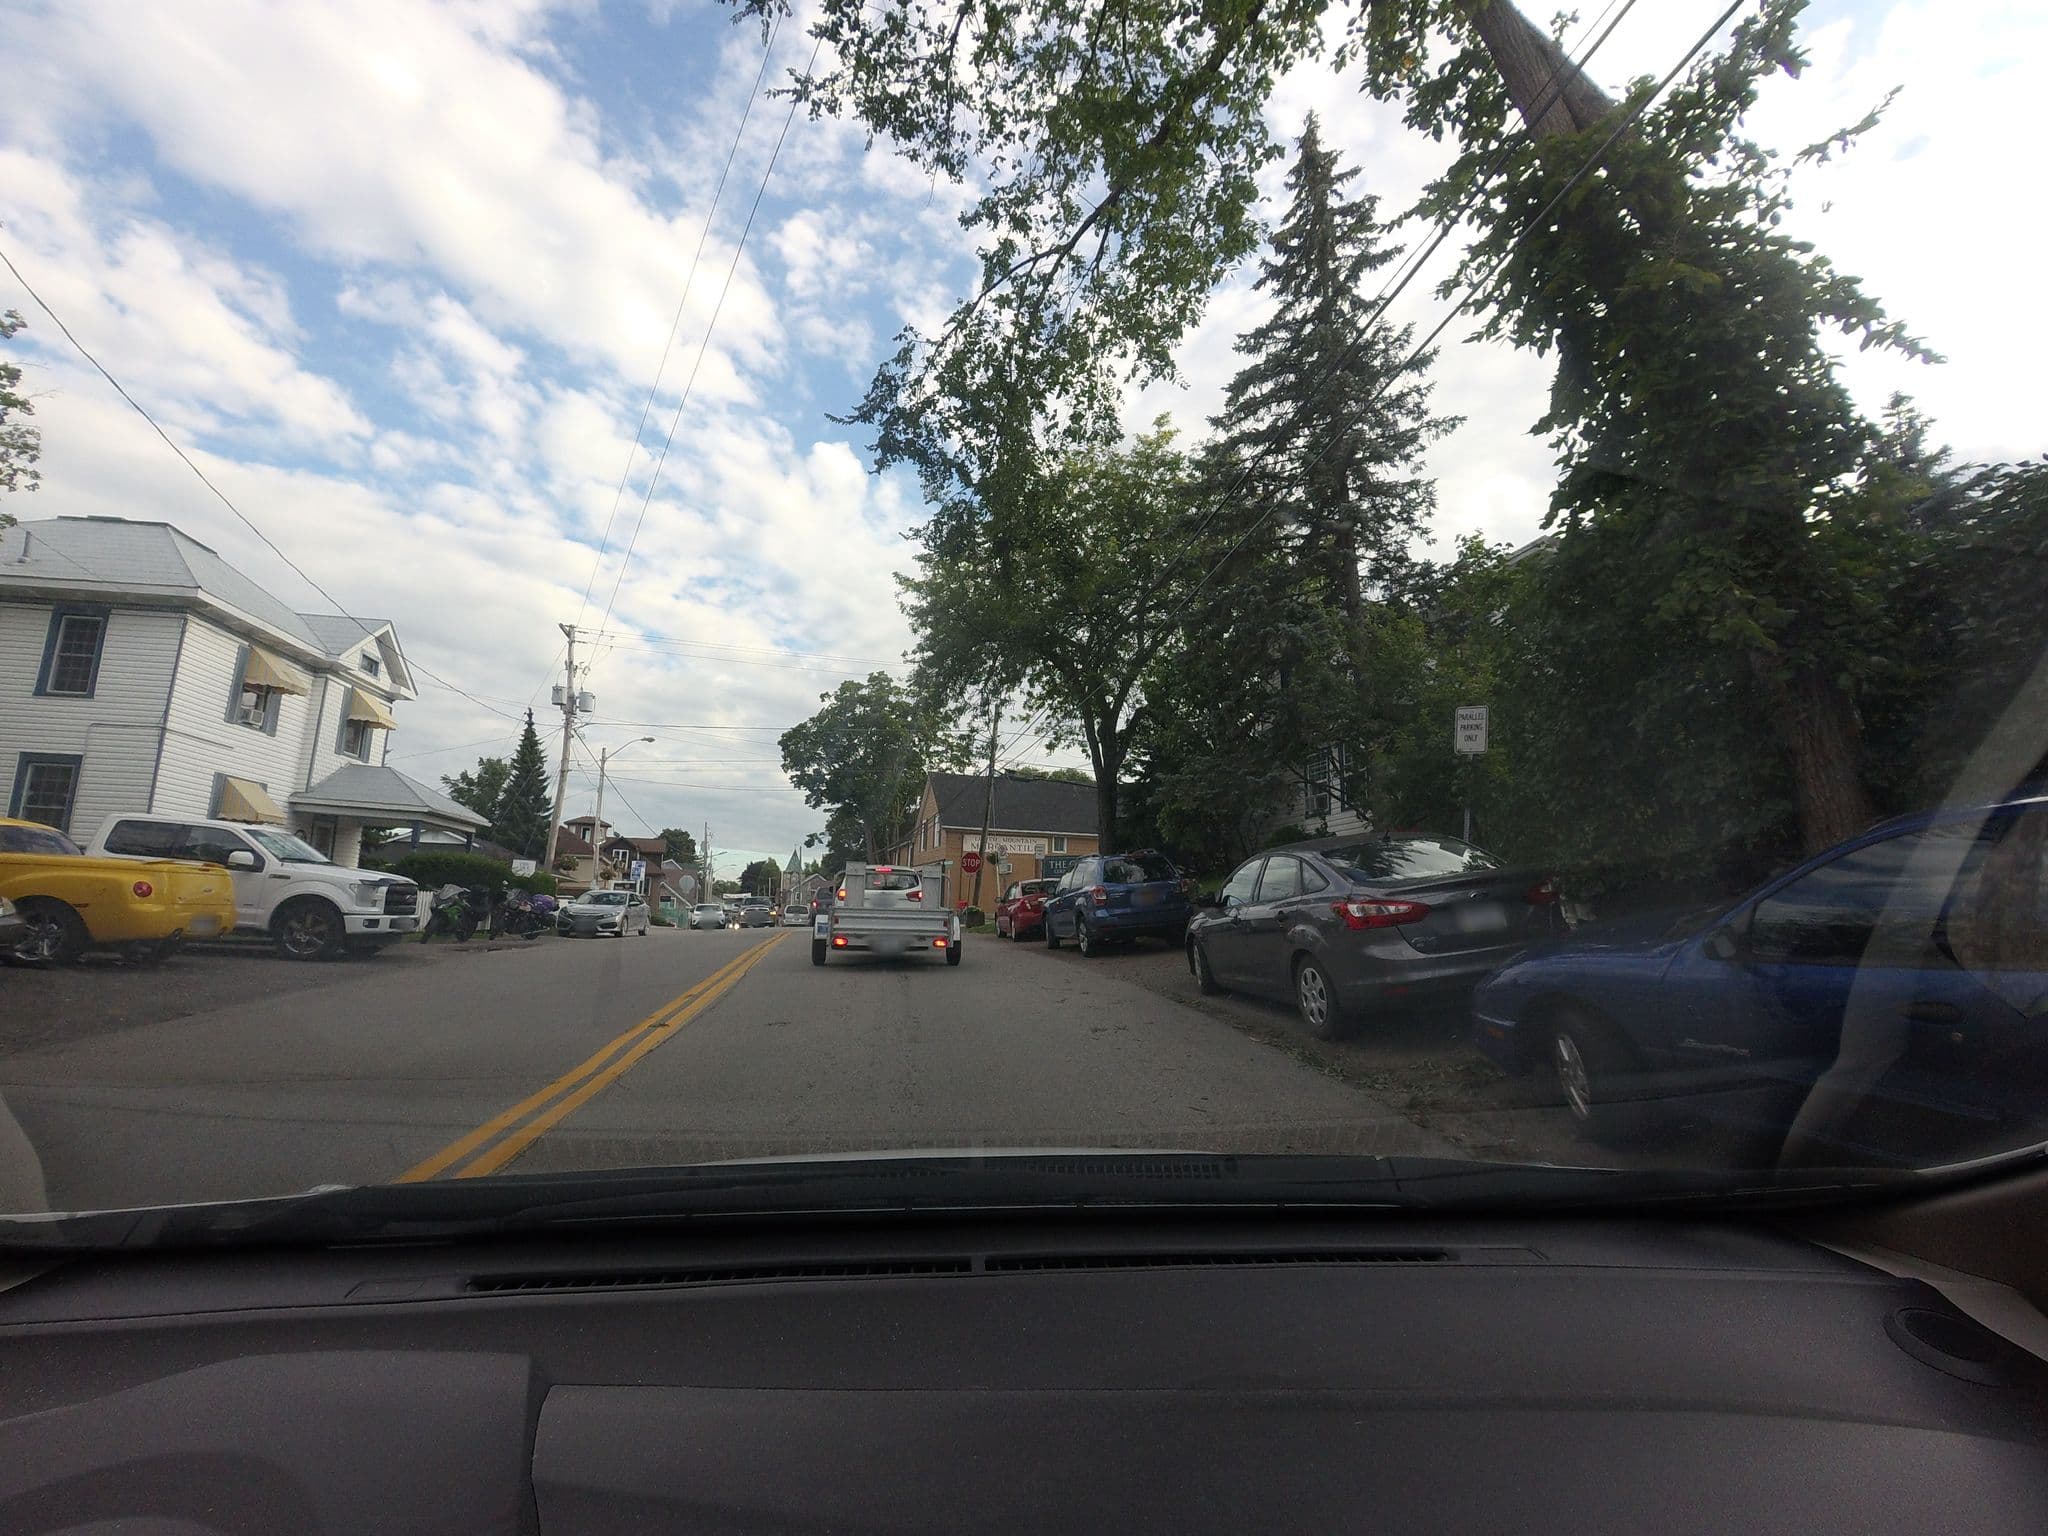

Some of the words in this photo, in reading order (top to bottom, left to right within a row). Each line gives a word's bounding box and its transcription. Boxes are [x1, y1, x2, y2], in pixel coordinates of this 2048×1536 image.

[1458, 712, 1484, 720] PARALLEL
[1460, 723, 1483, 731] PARKING
[1464, 734, 1478, 742] ONLY
[962, 858, 980, 868] STOP
[1049, 860, 1067, 869] THE
